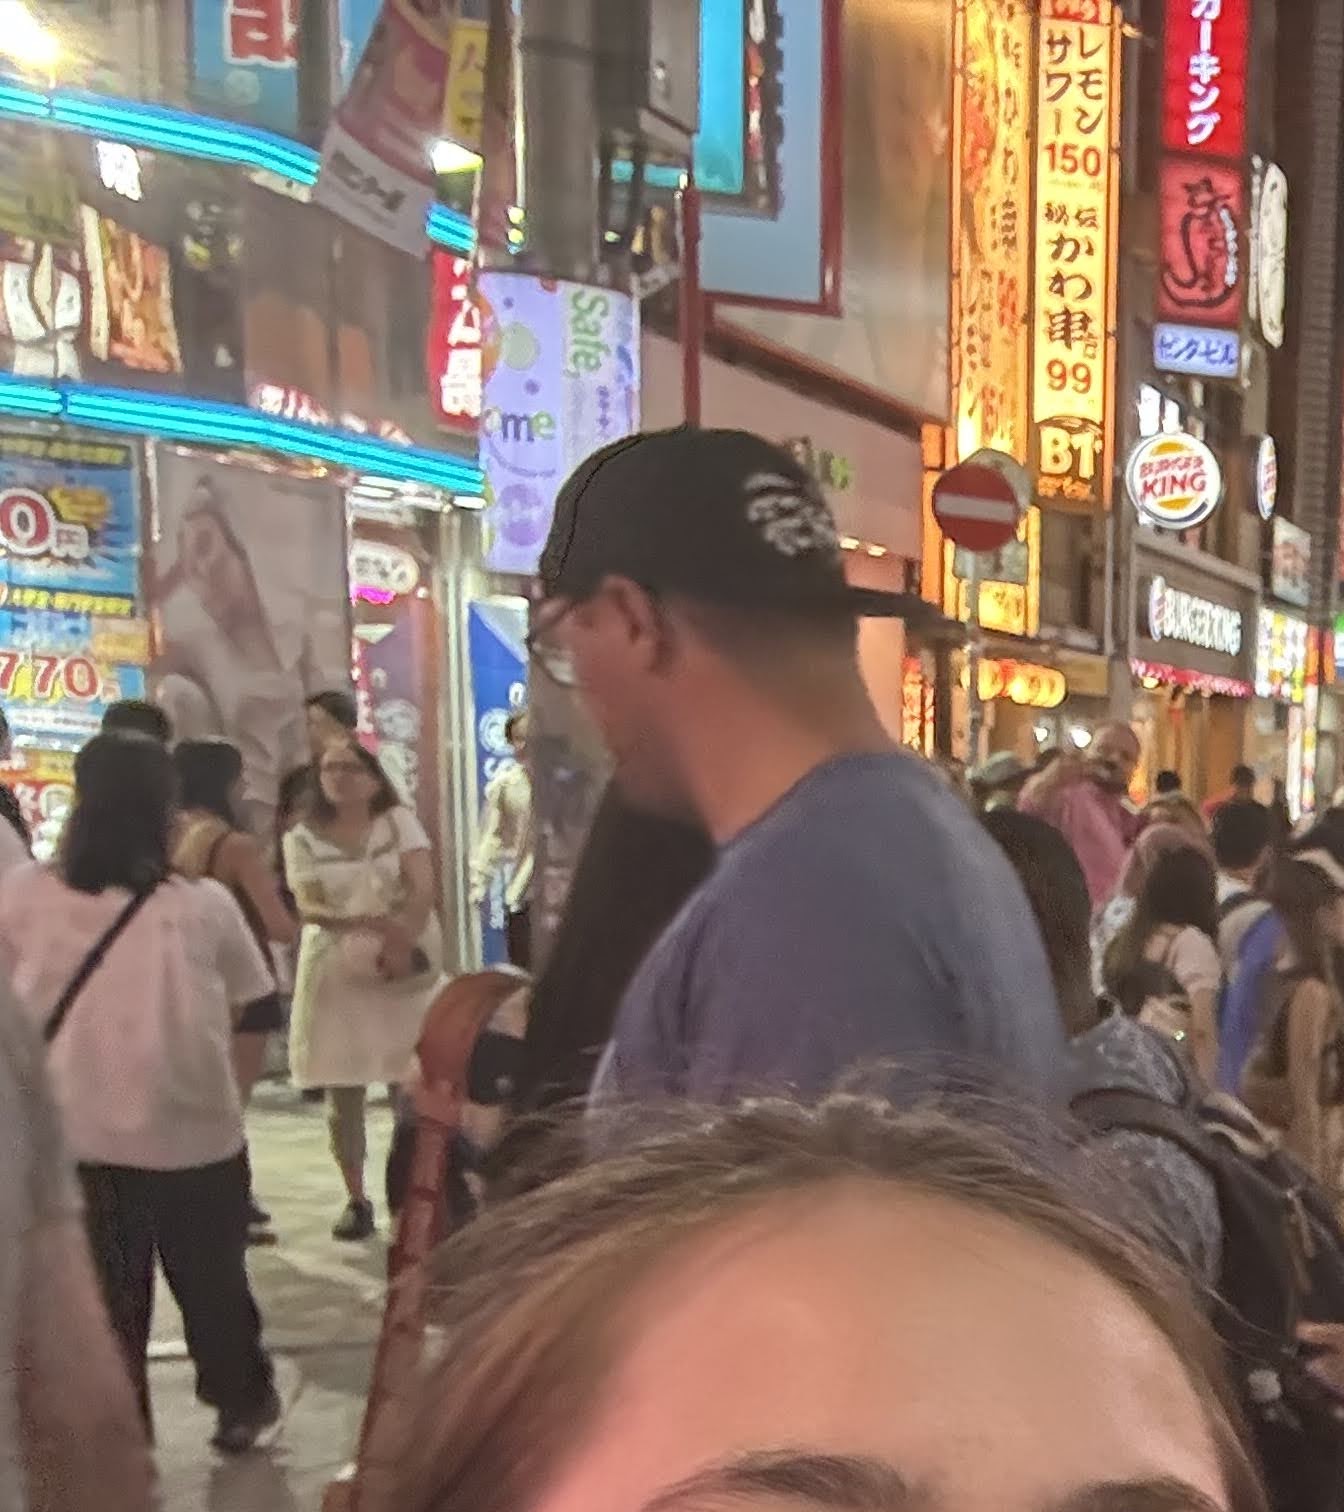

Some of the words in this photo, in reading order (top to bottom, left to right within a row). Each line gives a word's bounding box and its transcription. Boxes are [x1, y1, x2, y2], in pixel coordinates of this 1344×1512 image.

[1044, 143, 1103, 177] 150
[1047, 233, 1094, 350] かわ串
[1046, 359, 1092, 395] 99
[1139, 473, 1207, 500] KING
